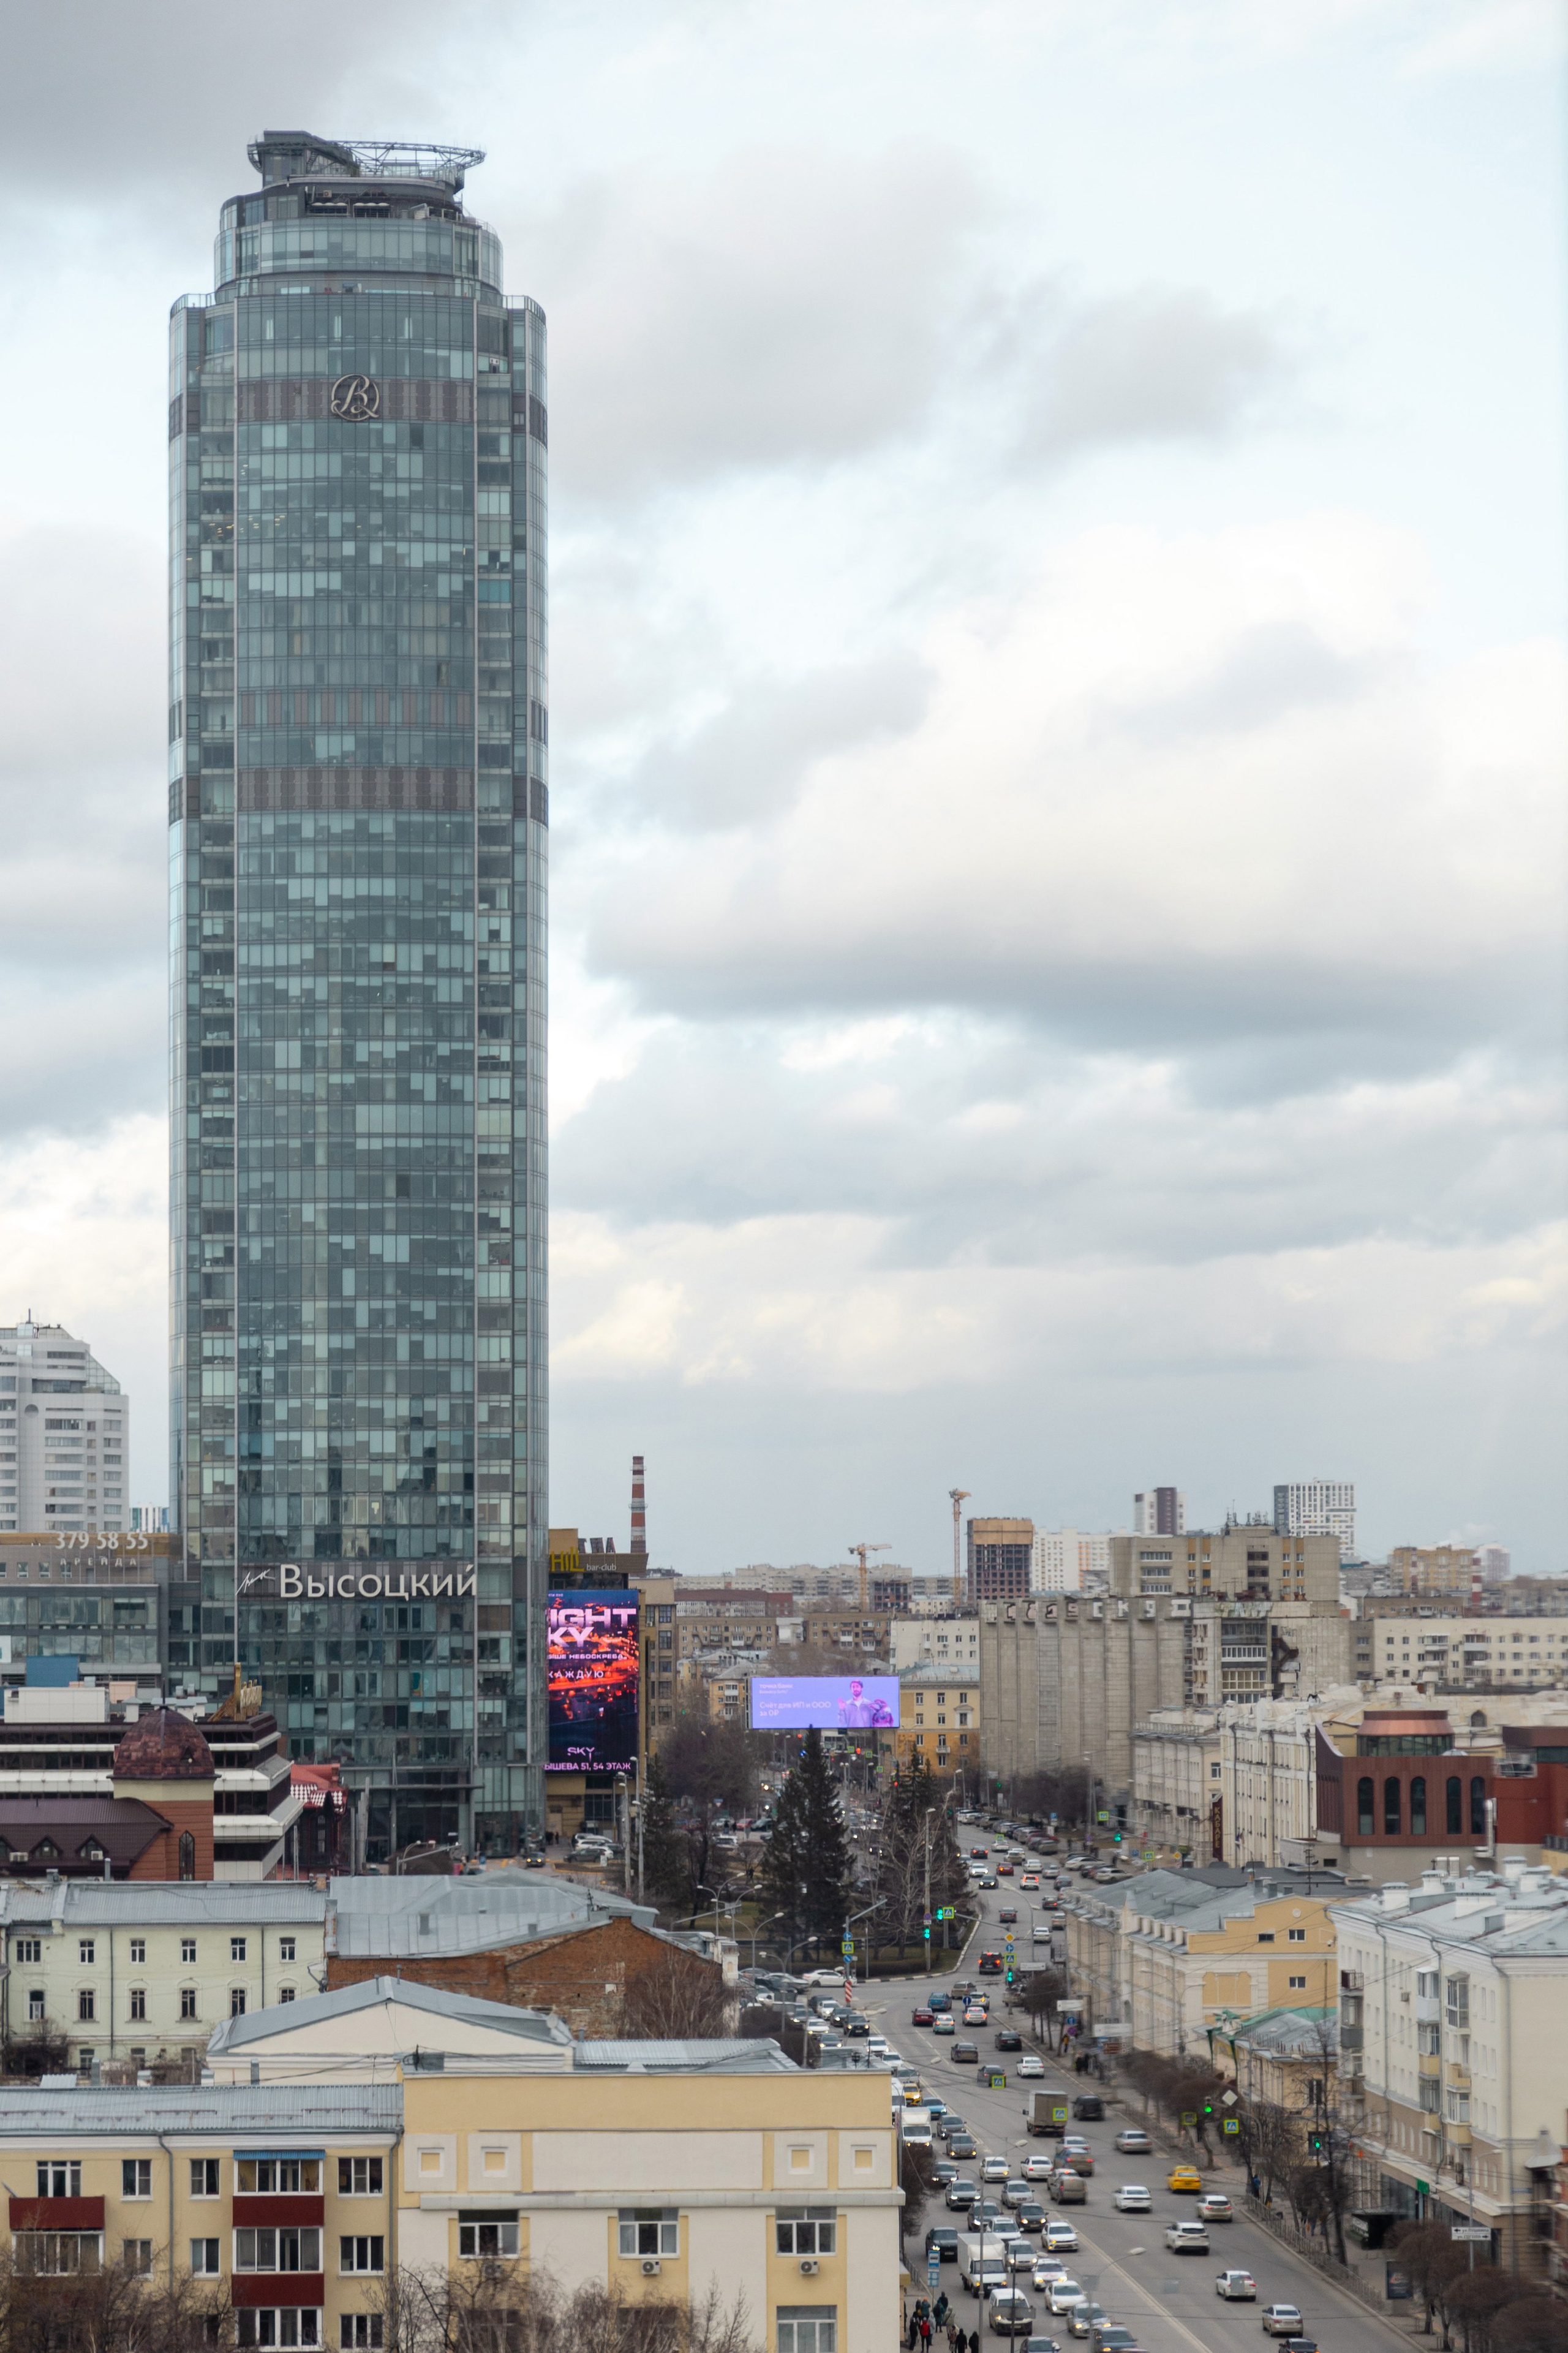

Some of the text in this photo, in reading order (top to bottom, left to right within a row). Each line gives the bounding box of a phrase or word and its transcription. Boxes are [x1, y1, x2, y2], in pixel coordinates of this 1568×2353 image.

[55, 1532, 148, 1549] 379 58 55
[60, 1557, 137, 1567] АРЕНДА
[280, 1564, 477, 1601] Высоцкий
[549, 1608, 636, 1629] IGHT
[548, 1626, 594, 1648] KY
[567, 1747, 595, 1762] SKY
[581, 1762, 591, 1771] 51,
